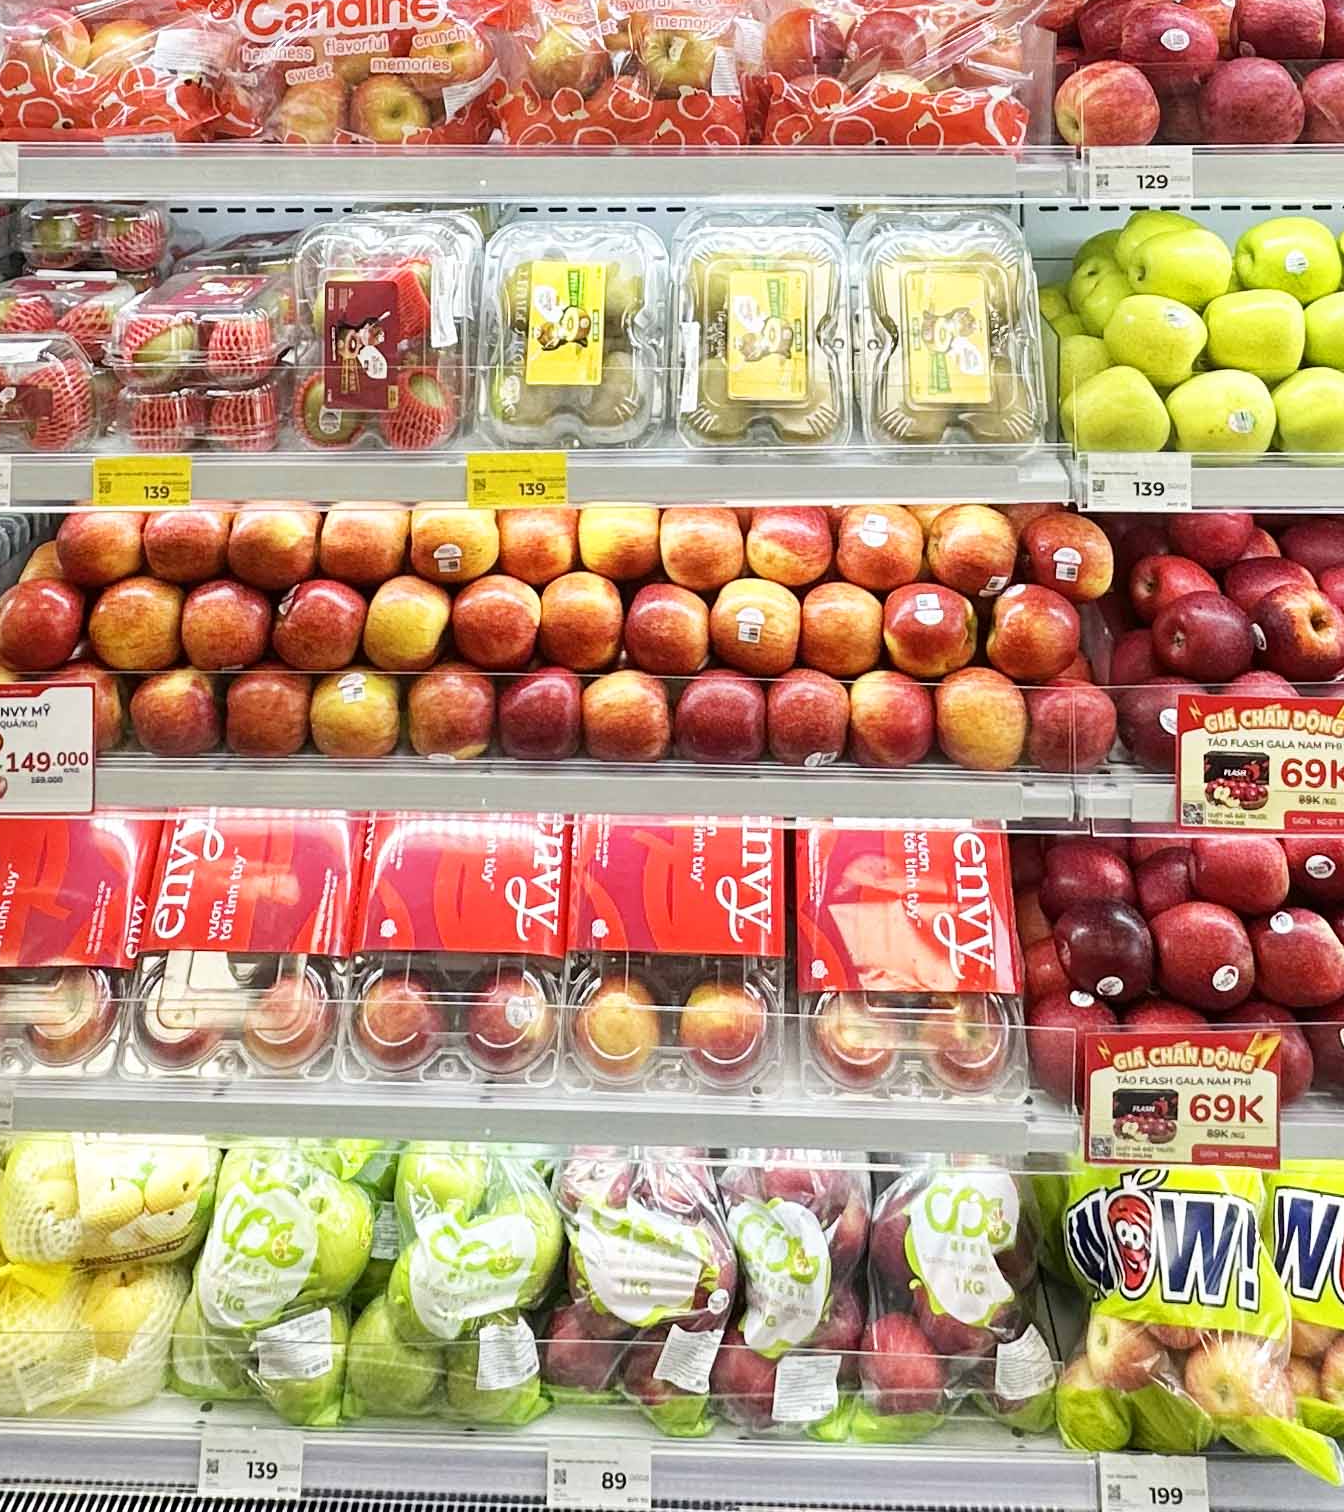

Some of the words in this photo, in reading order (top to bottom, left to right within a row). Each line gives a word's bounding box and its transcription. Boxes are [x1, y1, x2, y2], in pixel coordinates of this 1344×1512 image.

[325, 34, 389, 54] flavorful
[414, 29, 466, 48] crunch
[286, 65, 332, 83] sweet
[371, 58, 451, 72] memories
[1136, 174, 1169, 190] 129
[143, 485, 170, 499] 139
[518, 482, 546, 497] 139
[1133, 481, 1165, 497] 139
[1204, 707, 1238, 734] GIÁ
[1240, 703, 1290, 730] CHẤN
[1208, 737, 1227, 747] TÁO
[1230, 739, 1264, 749] FLASH
[1266, 740, 1295, 749] GALA
[1298, 741, 1322, 750] NAM
[6, 751, 89, 773] 149.000
[933, 830, 996, 980] envy
[1113, 1045, 1147, 1072] GIÁ
[1149, 1040, 1199, 1067] CHẤN
[1202, 1046, 1256, 1074] ĐỘNG
[1116, 1076, 1136, 1086] TÁO
[1139, 1076, 1173, 1086] FLASH
[1176, 1076, 1204, 1086] GALA
[1207, 1077, 1230, 1086] NAM
[1189, 1093, 1264, 1124] 69K
[1066, 1170, 1259, 1312] WOW!
[246, 1461, 278, 1480] 139
[601, 1471, 627, 1490] 89
[1148, 1487, 1183, 1505] 199
